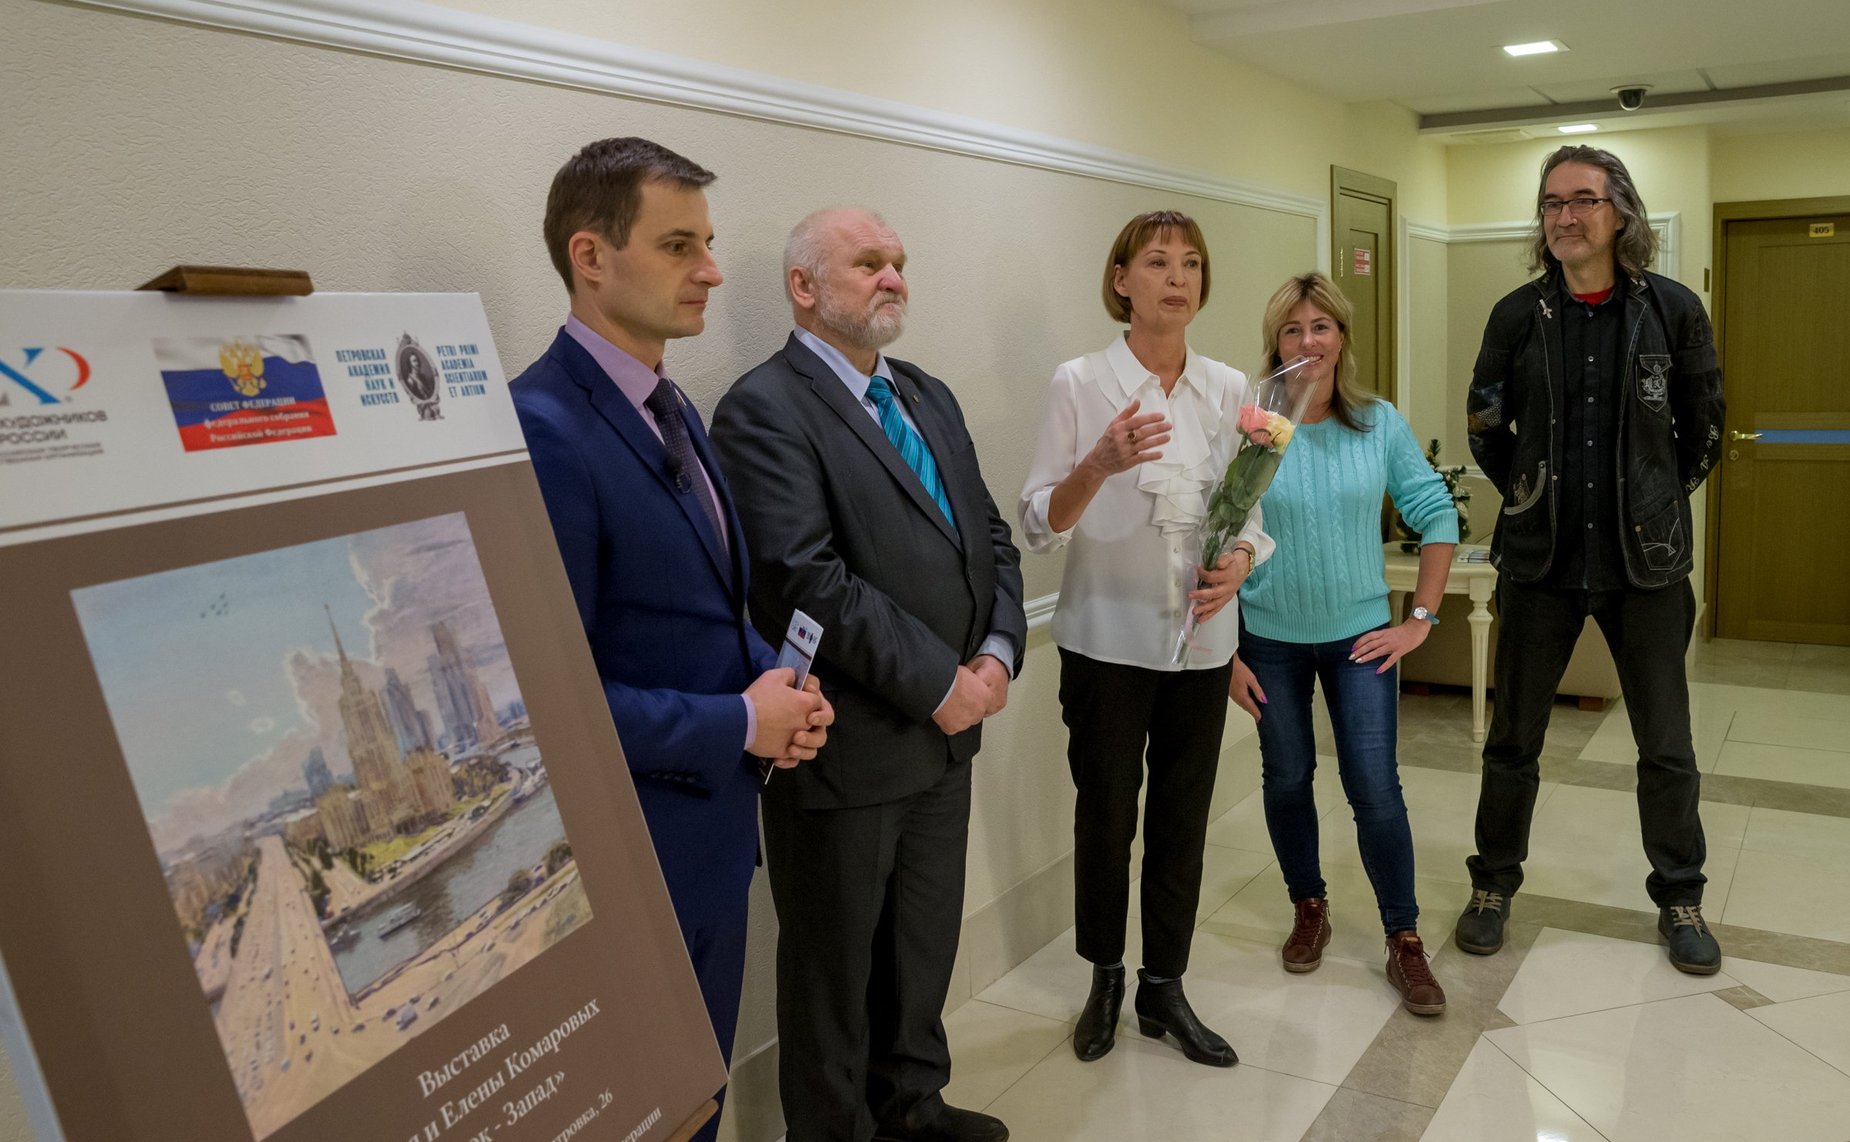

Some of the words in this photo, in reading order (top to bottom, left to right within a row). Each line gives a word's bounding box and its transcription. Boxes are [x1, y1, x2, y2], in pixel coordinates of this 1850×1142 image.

[1813, 226, 1830, 234] 405
[335, 348, 387, 363] ПЕТРОВСКАЯ
[436, 345, 457, 357] PETRI
[459, 344, 479, 355] PRIMI
[347, 363, 391, 377] АКАДЕМИЯ
[440, 358, 475, 370] ACADEMIA
[444, 370, 488, 384] SCIENTIARUM
[365, 378, 386, 391] НАУК
[388, 378, 396, 389] И
[448, 387, 458, 398] ET
[461, 384, 486, 397] ARTIUM
[210, 400, 240, 412] СОВЕТ
[242, 396, 296, 409] ФЕДЕРАЦИИ
[360, 392, 400, 406] ИСКУССТВ
[416, 1023, 511, 1098] Выставка
[423, 1120, 440, 1142] и
[439, 1070, 506, 1130] Елены
[504, 998, 601, 1081] Комаровых
[502, 1070, 565, 1126] Запад»
[598, 1087, 614, 1109] 26
